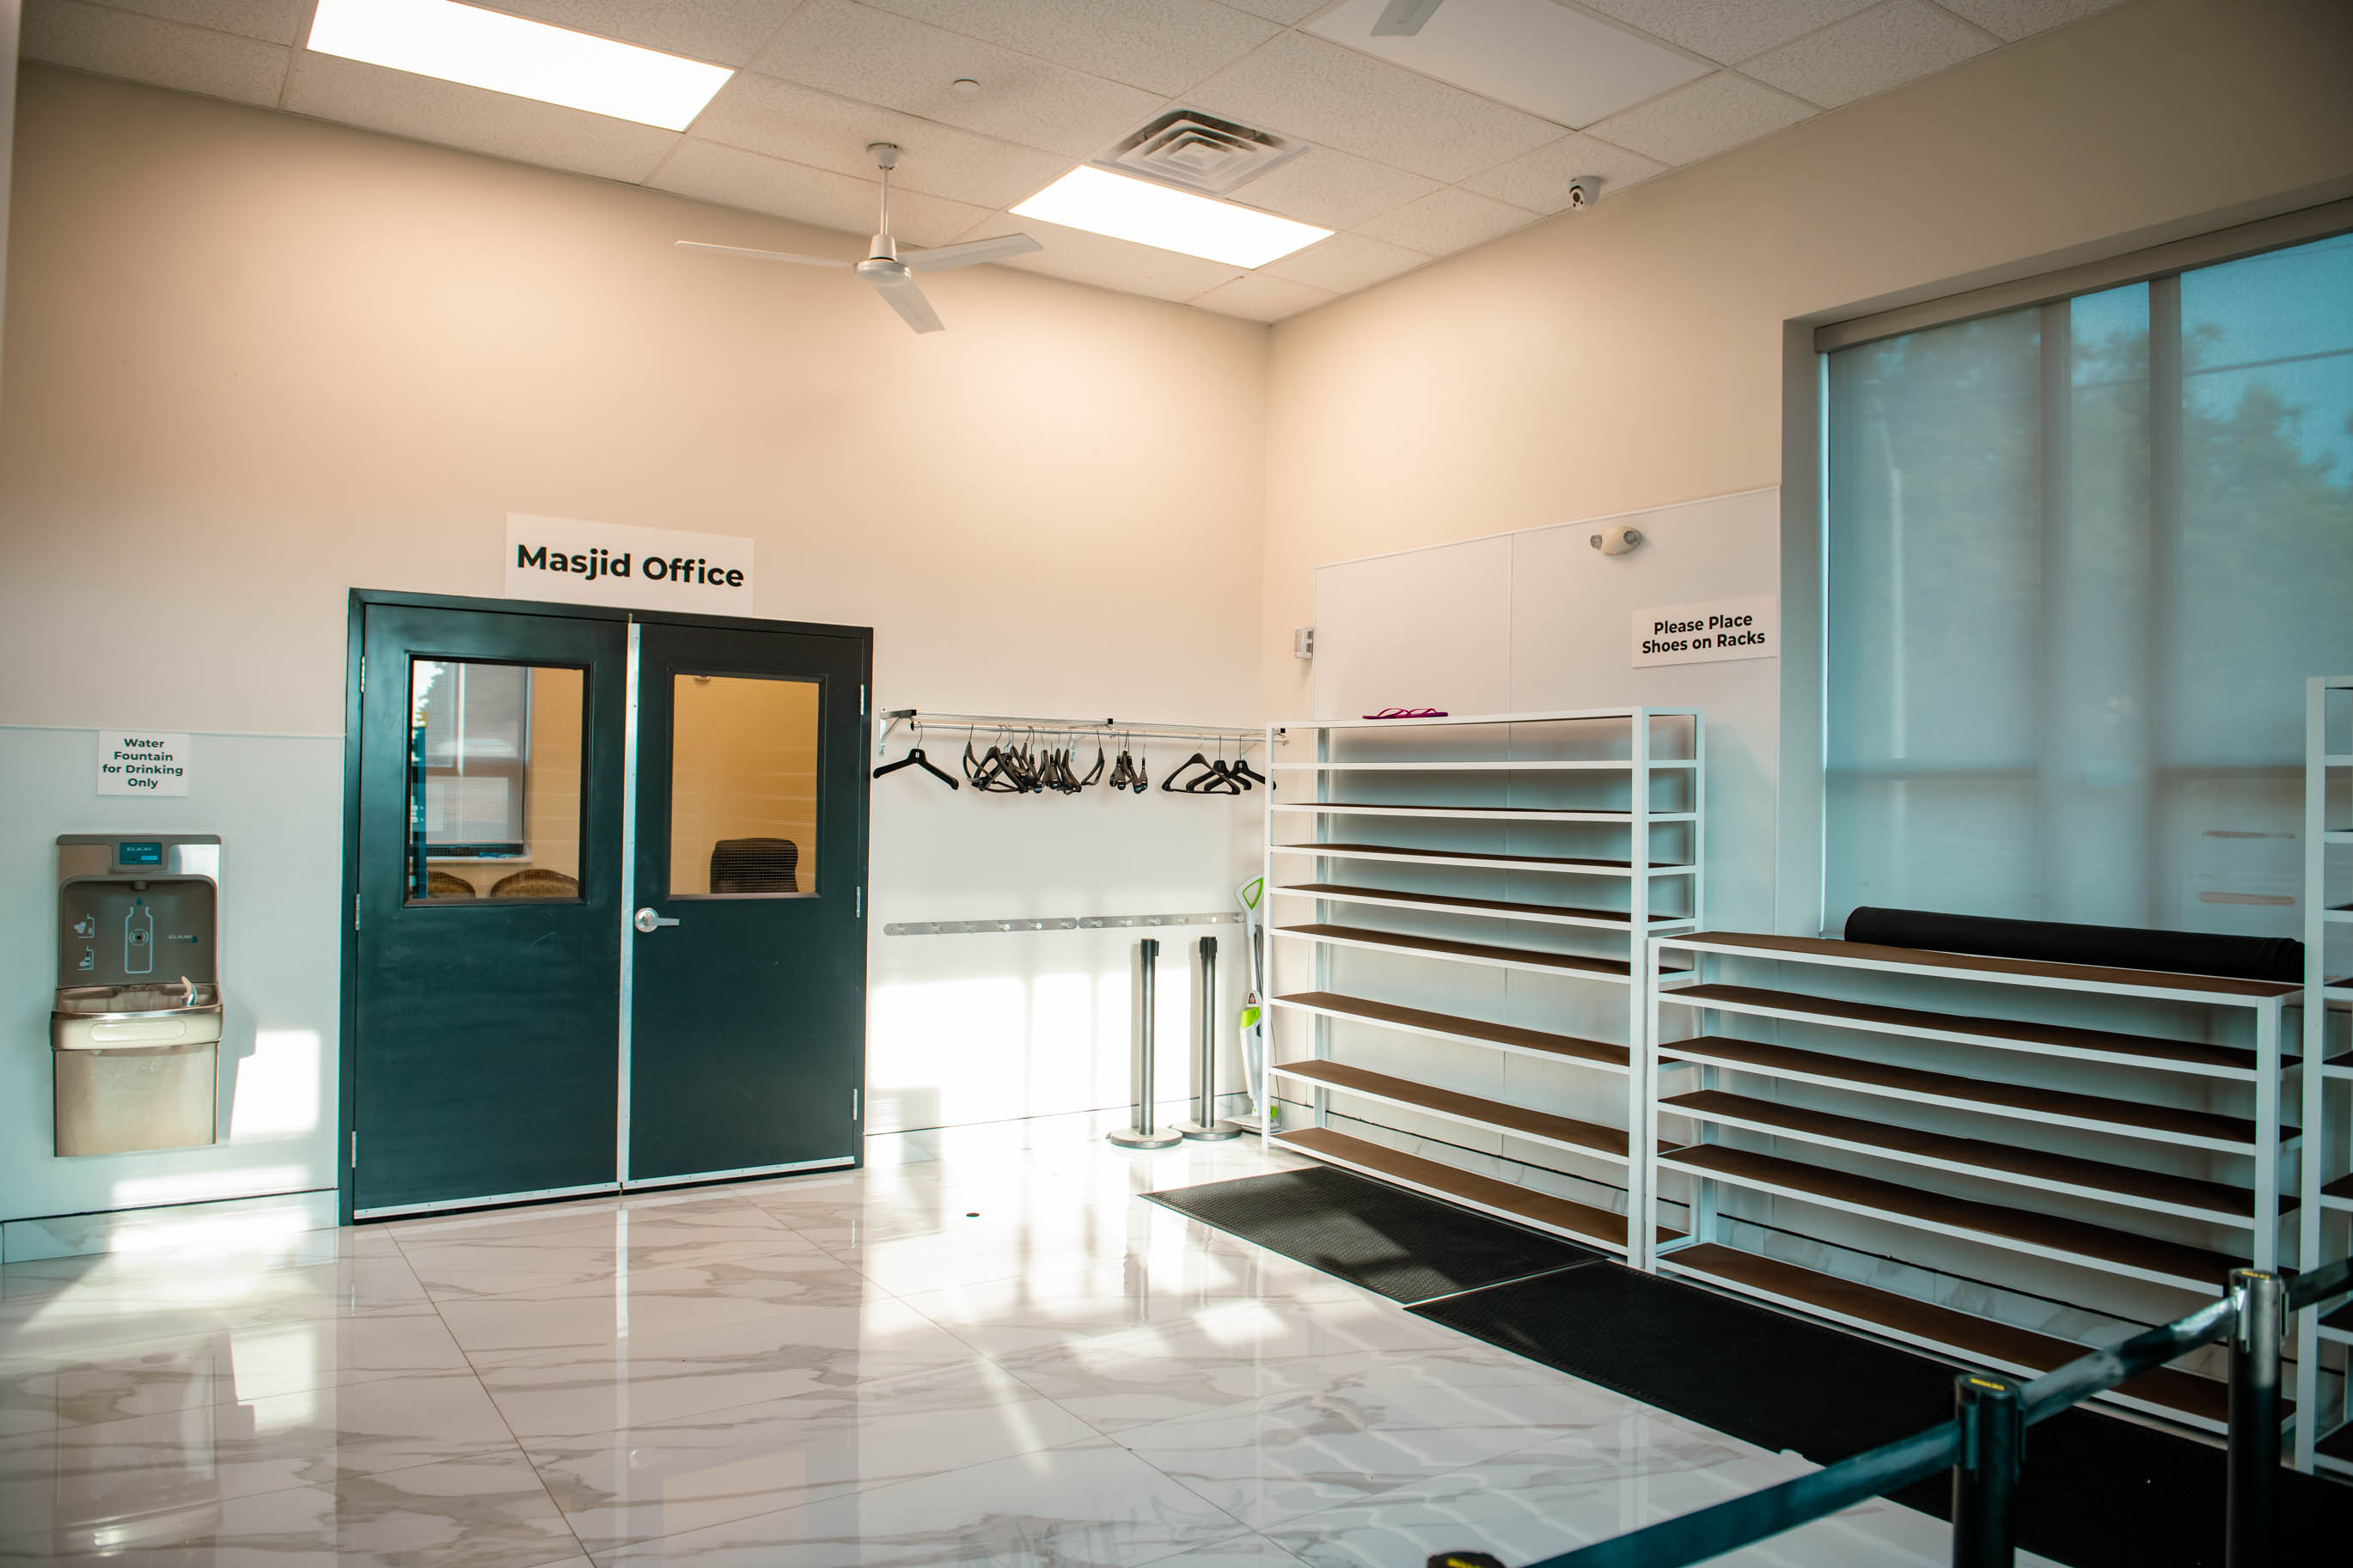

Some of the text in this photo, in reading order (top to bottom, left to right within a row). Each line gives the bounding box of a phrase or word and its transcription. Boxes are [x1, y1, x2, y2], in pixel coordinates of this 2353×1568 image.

[516, 544, 745, 588] Masjid Office
[1653, 614, 1753, 635] Please Place
[1642, 631, 1766, 654] Shoes on Racks
[124, 738, 164, 747] Water
[113, 751, 174, 761] Fountain
[102, 763, 184, 777] for Drinking
[127, 778, 158, 789] Only
